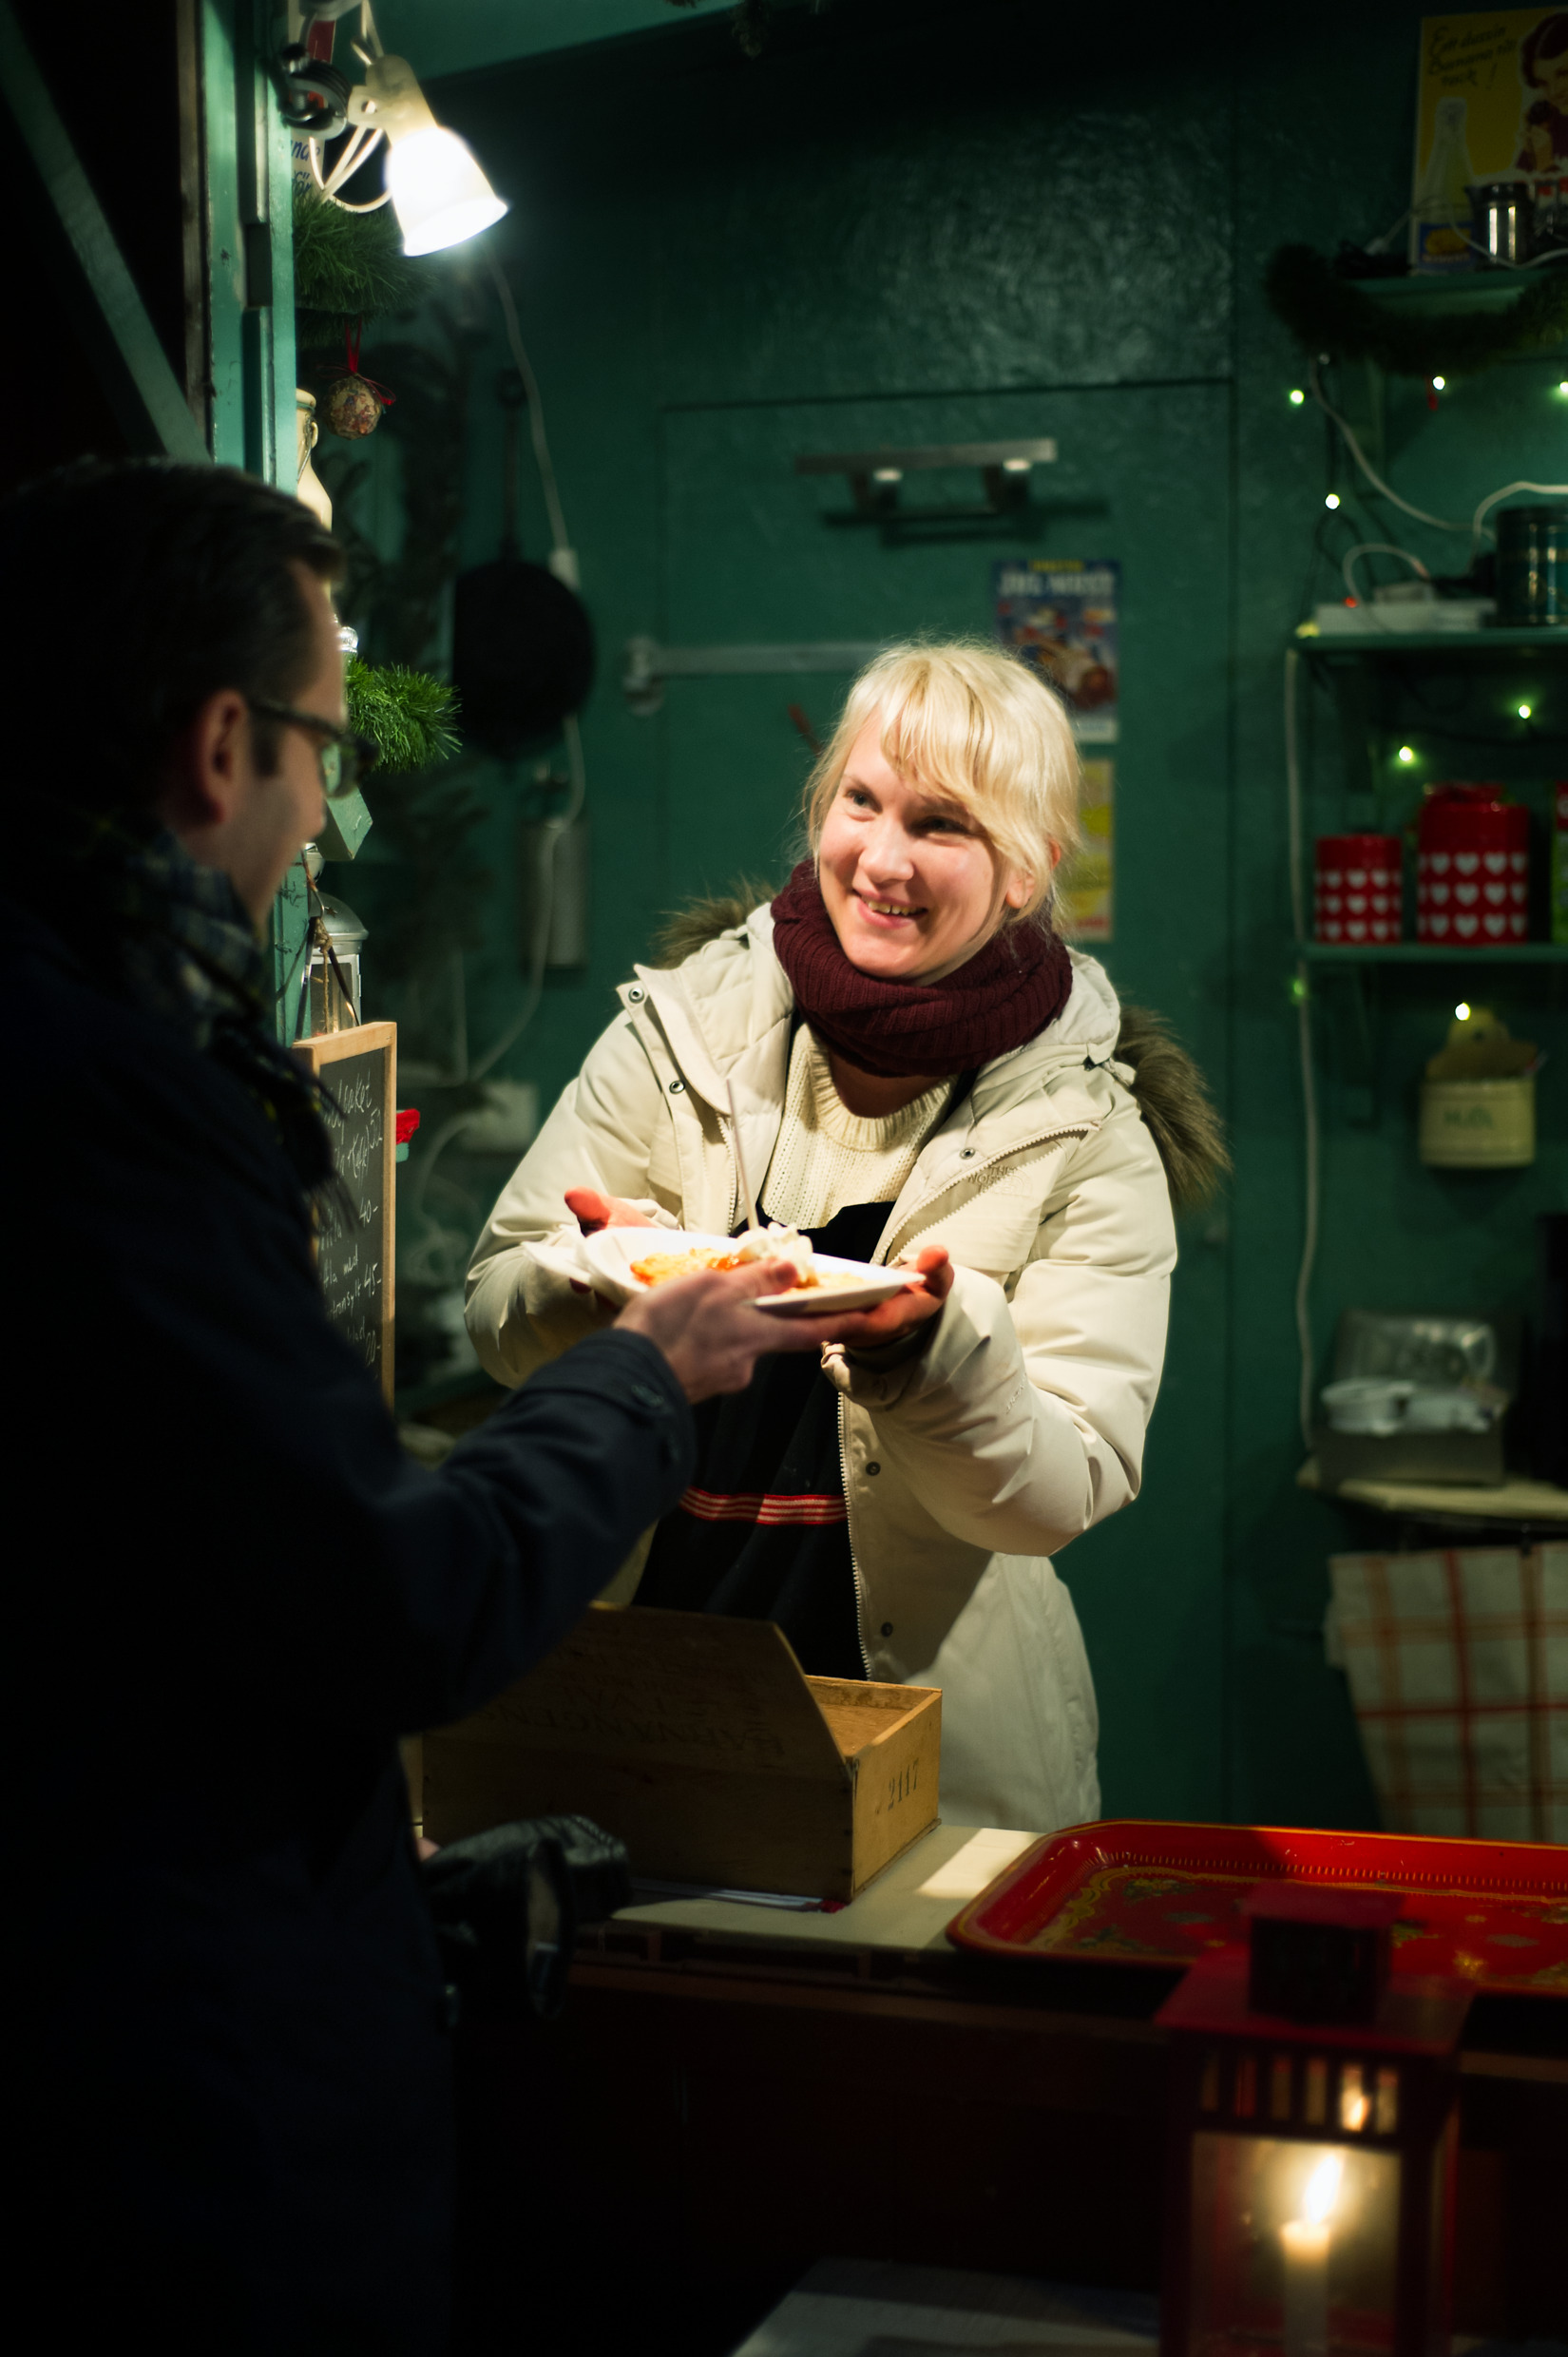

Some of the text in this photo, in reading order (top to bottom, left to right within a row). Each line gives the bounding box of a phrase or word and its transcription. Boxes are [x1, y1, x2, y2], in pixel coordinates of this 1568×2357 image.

[359, 1197, 379, 1228] 40-
[363, 1262, 382, 1298] 45-
[888, 1757, 920, 1811] 2117
